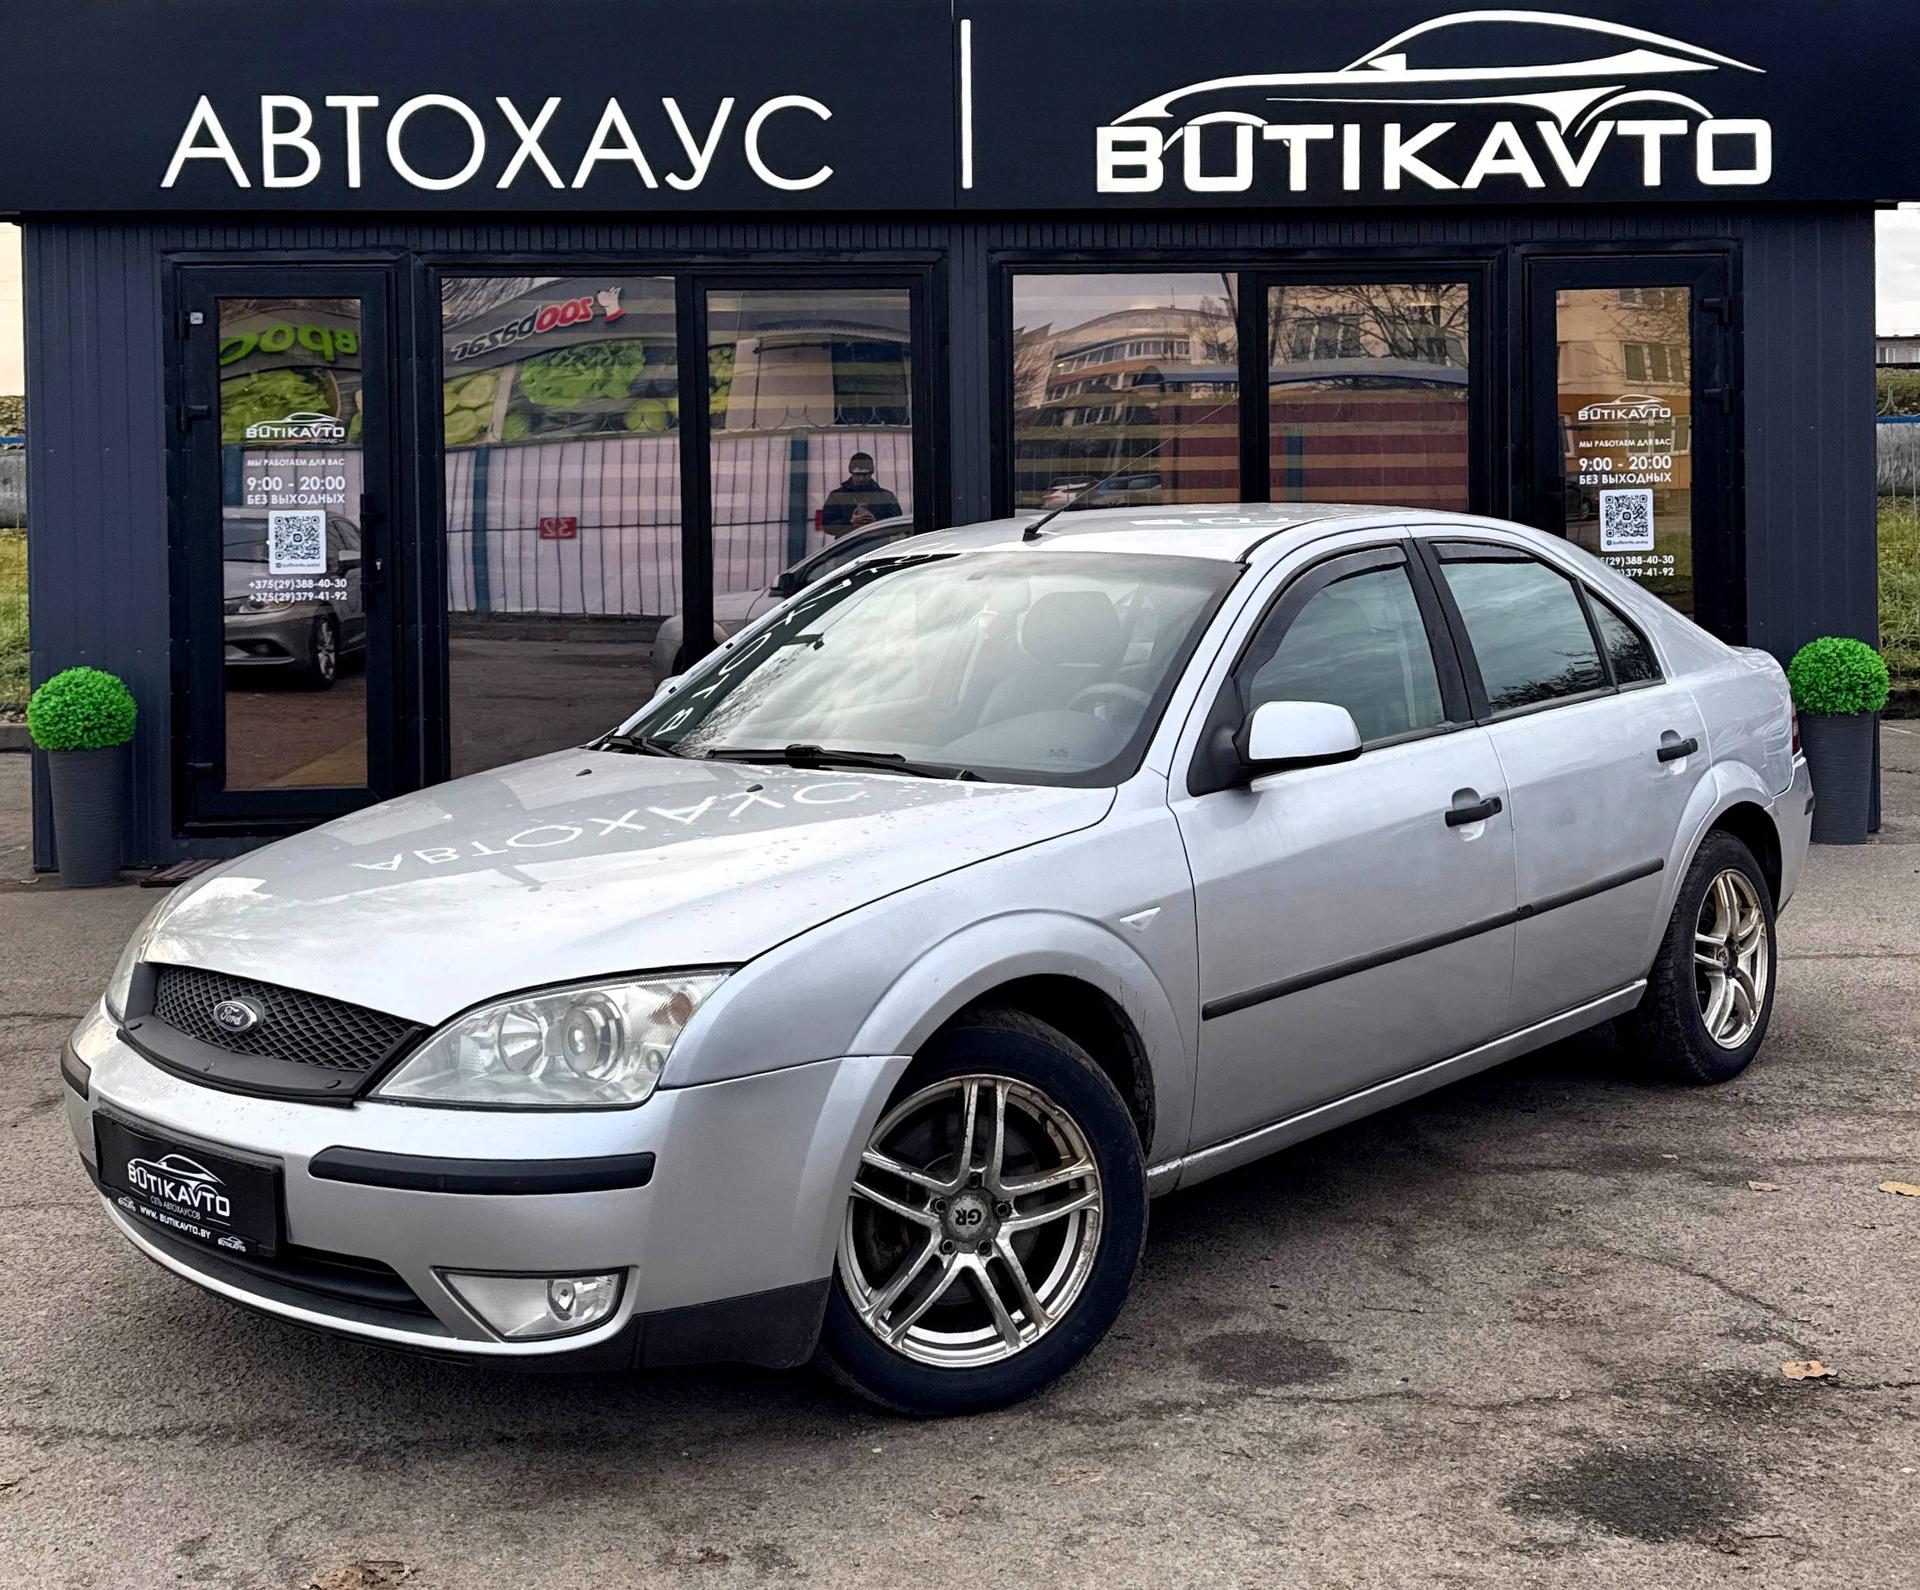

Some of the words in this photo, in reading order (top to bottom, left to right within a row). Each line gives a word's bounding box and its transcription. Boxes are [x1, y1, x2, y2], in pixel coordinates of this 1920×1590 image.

[160, 93, 834, 191] АВТОХАУС
[1096, 118, 1773, 193] BUTIKAVTO
[1578, 407, 1671, 421] BUTIKAVTO
[246, 426, 345, 438] BUTIKAVTO
[1579, 440, 1593, 448] МЫ
[1594, 439, 1635, 447] РАБОТАЕМ
[1655, 438, 1672, 446] ВАС
[1579, 456, 1612, 472] 9:00
[1628, 455, 1672, 470] 20:00
[247, 476, 282, 491] 9:00
[300, 475, 346, 490] 20:00
[1579, 474, 1599, 485] БЕЗ
[1602, 472, 1672, 484] ВЫХОДНЫХ
[247, 494, 268, 505] БЕЗ
[271, 493, 345, 504] ВЫХОДНЫХ
[249, 578, 347, 591] +375(29)388-40-30
[249, 591, 348, 603] +375(29)379-41-92
[220, 1005, 244, 1026] Ford
[127, 1163, 230, 1217] BUTIKAVTO
[954, 1208, 983, 1226] GR
